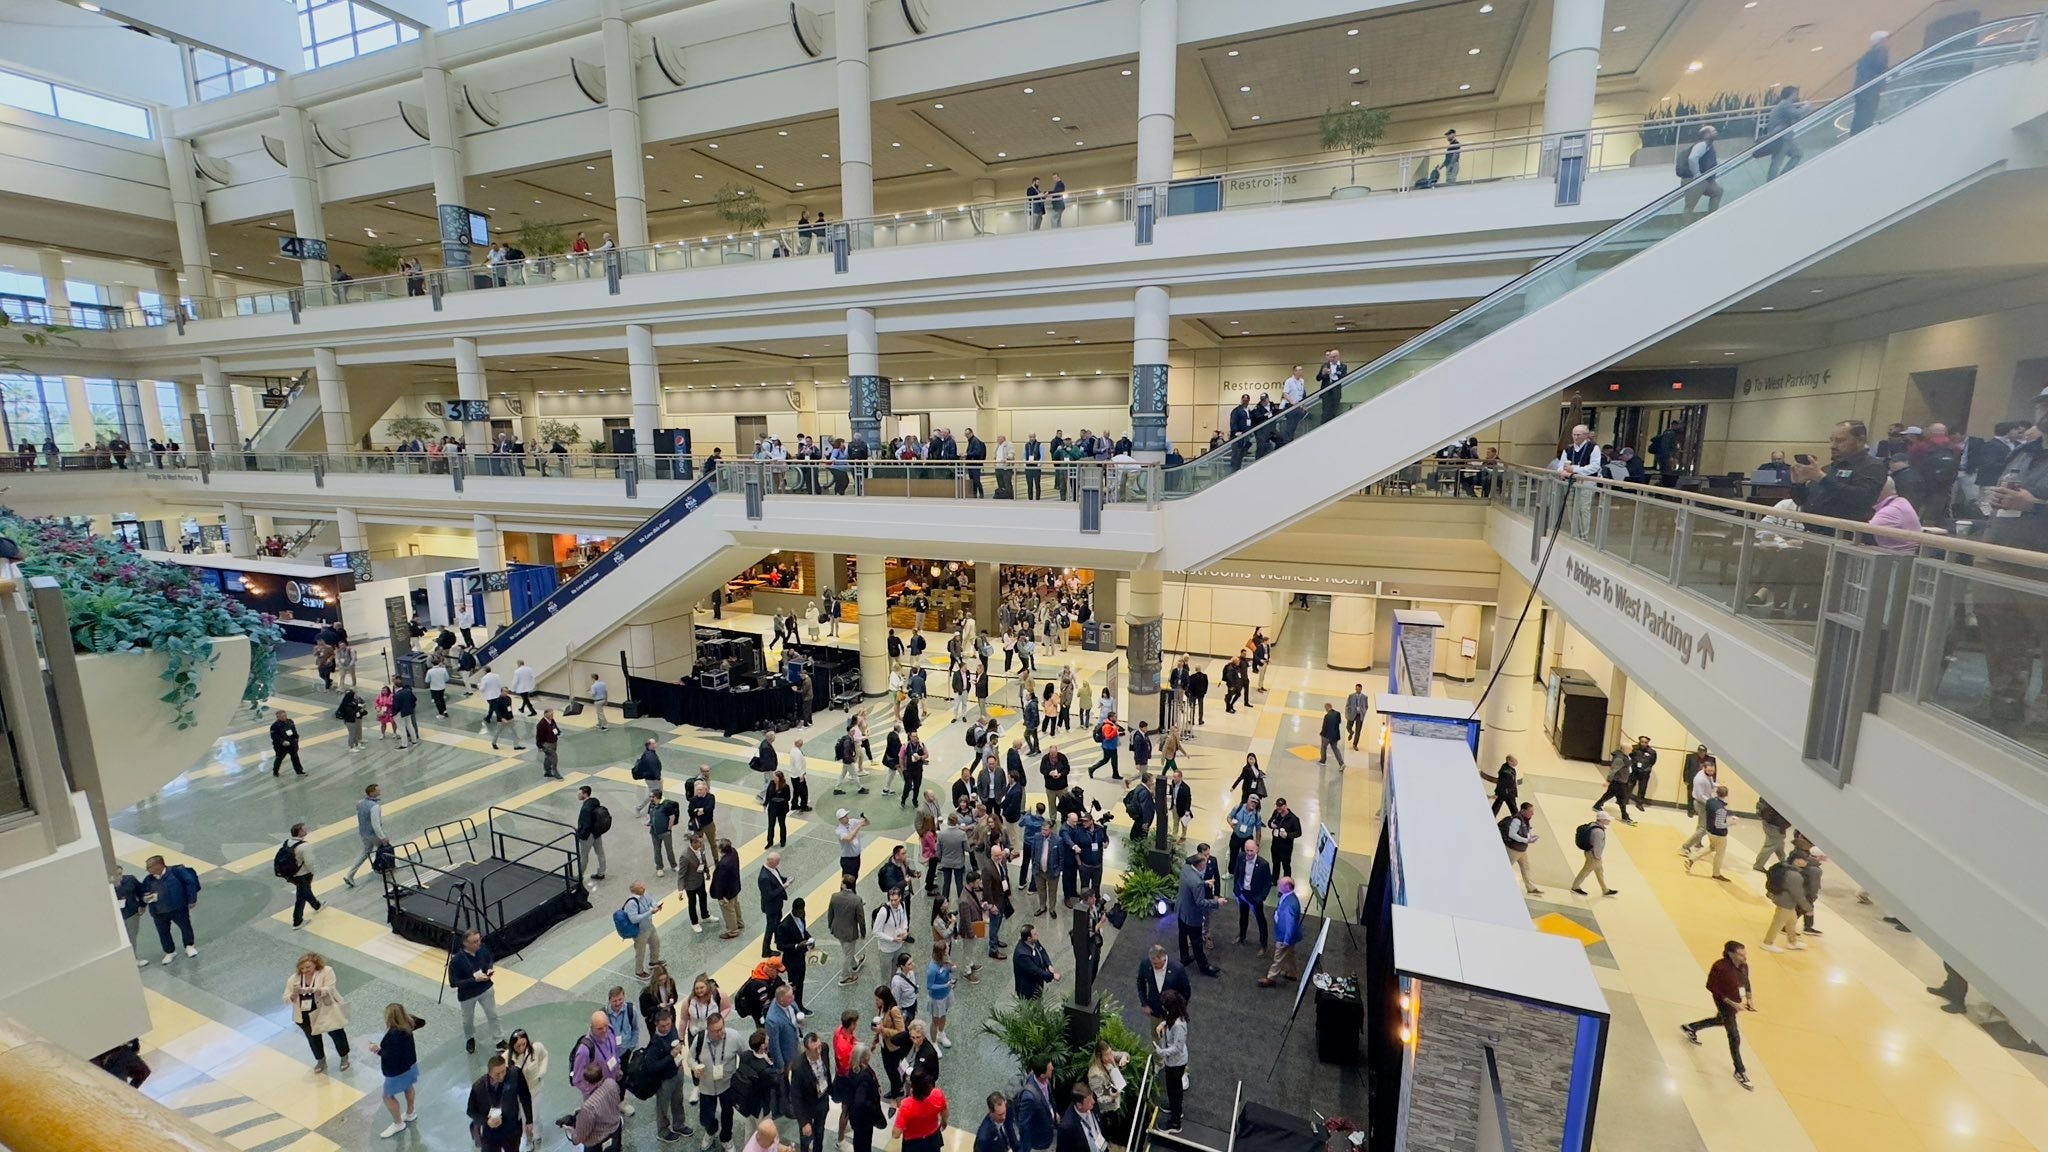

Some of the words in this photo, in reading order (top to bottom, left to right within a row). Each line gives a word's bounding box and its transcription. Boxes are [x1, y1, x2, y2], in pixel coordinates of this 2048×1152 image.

[281, 237, 300, 257] 4
[1223, 380, 1286, 391] Restroom
[1753, 377, 1763, 393] To
[1764, 376, 1785, 391] West
[1785, 368, 1820, 390] Parking
[447, 401, 462, 420] 3
[466, 574, 483, 595] 2
[302, 597, 324, 609] SHOW
[1573, 561, 1602, 597] Bridges
[1603, 577, 1613, 604] To
[1615, 583, 1642, 623] West
[1642, 601, 1694, 665] Parking
